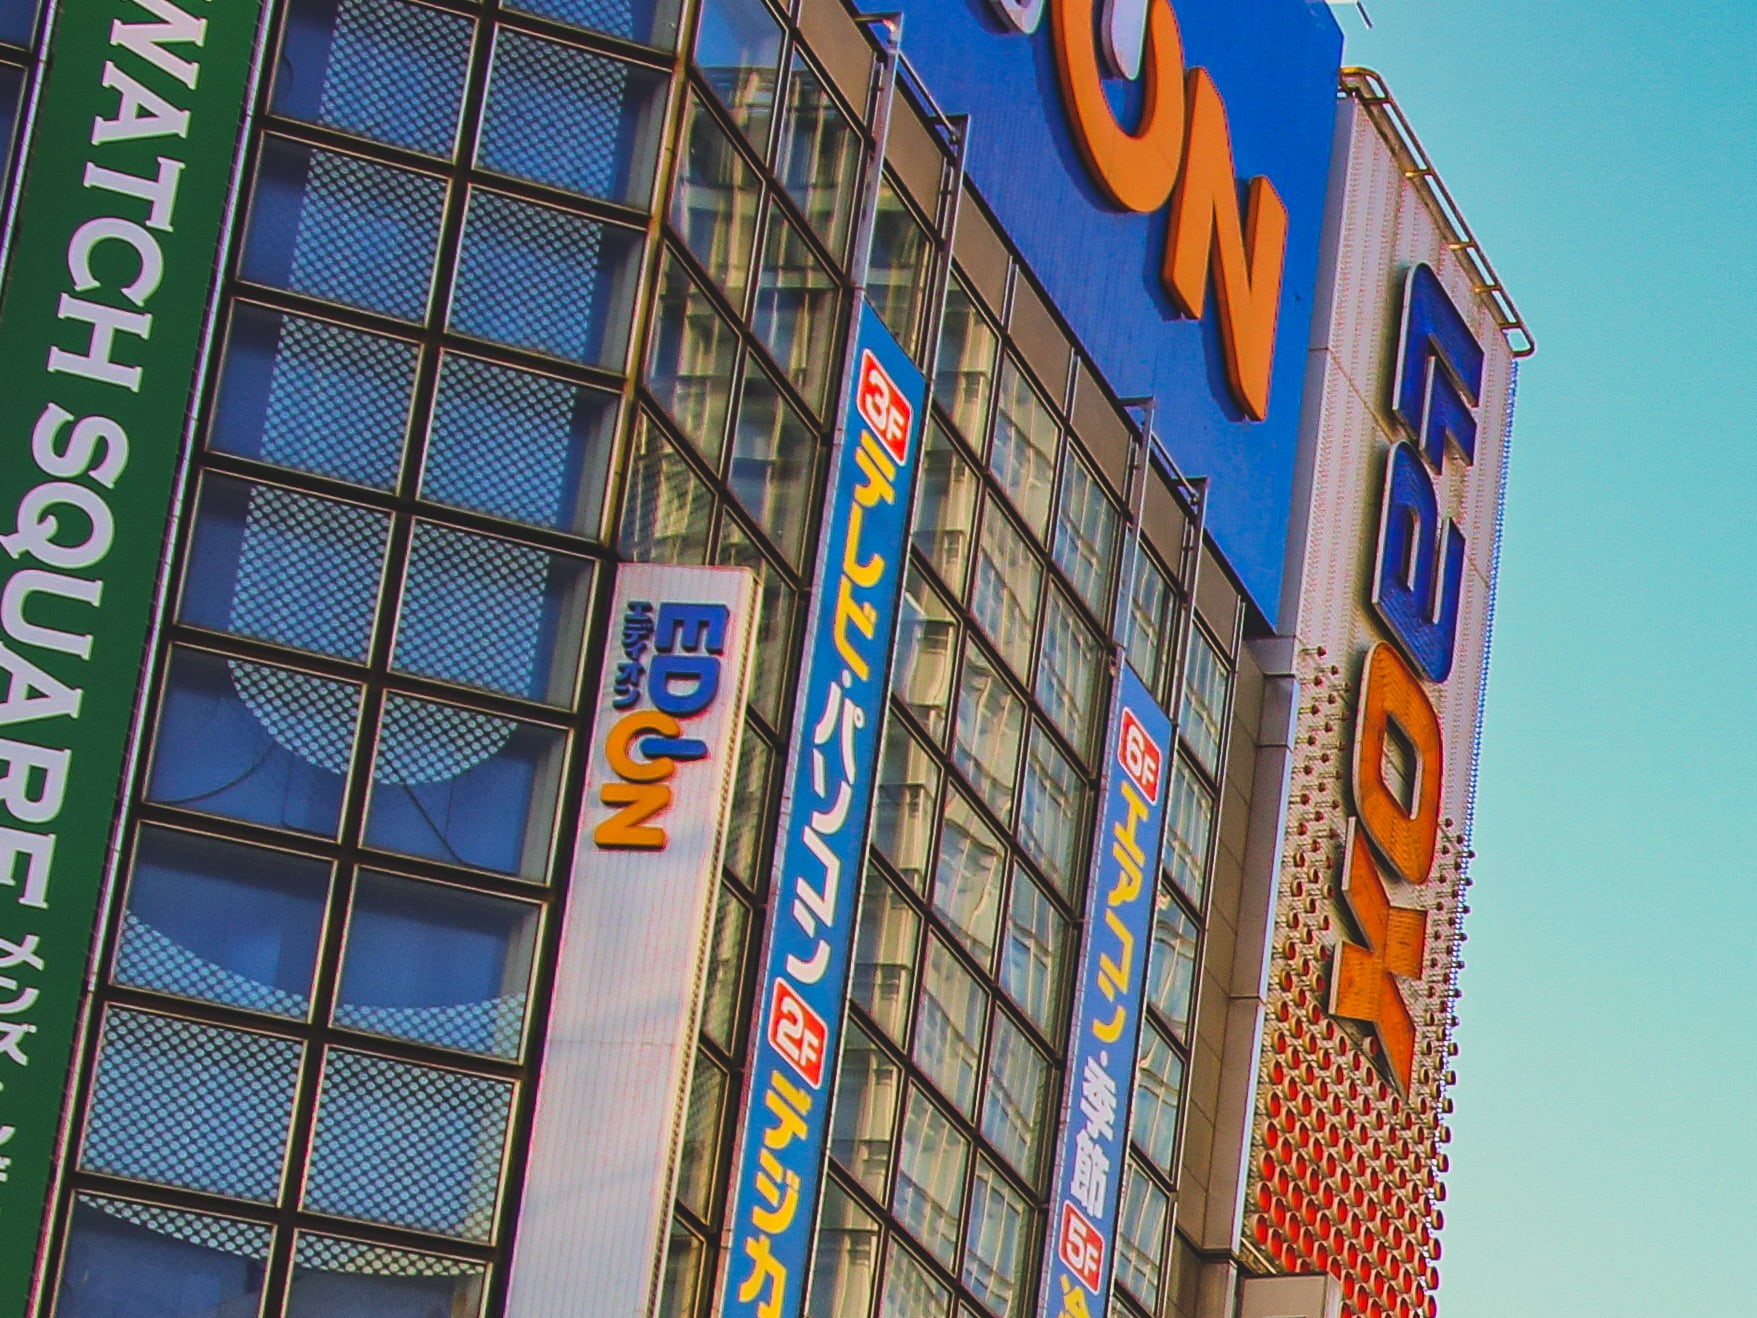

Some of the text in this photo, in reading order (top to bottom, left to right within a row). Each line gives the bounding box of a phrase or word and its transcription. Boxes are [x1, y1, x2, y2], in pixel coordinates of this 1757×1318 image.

[865, 366, 904, 459] 3F
[594, 600, 731, 852] EDION
[1124, 718, 1156, 800] 6F
[776, 993, 820, 1082] 2F
[1065, 1213, 1099, 1289] 5F
